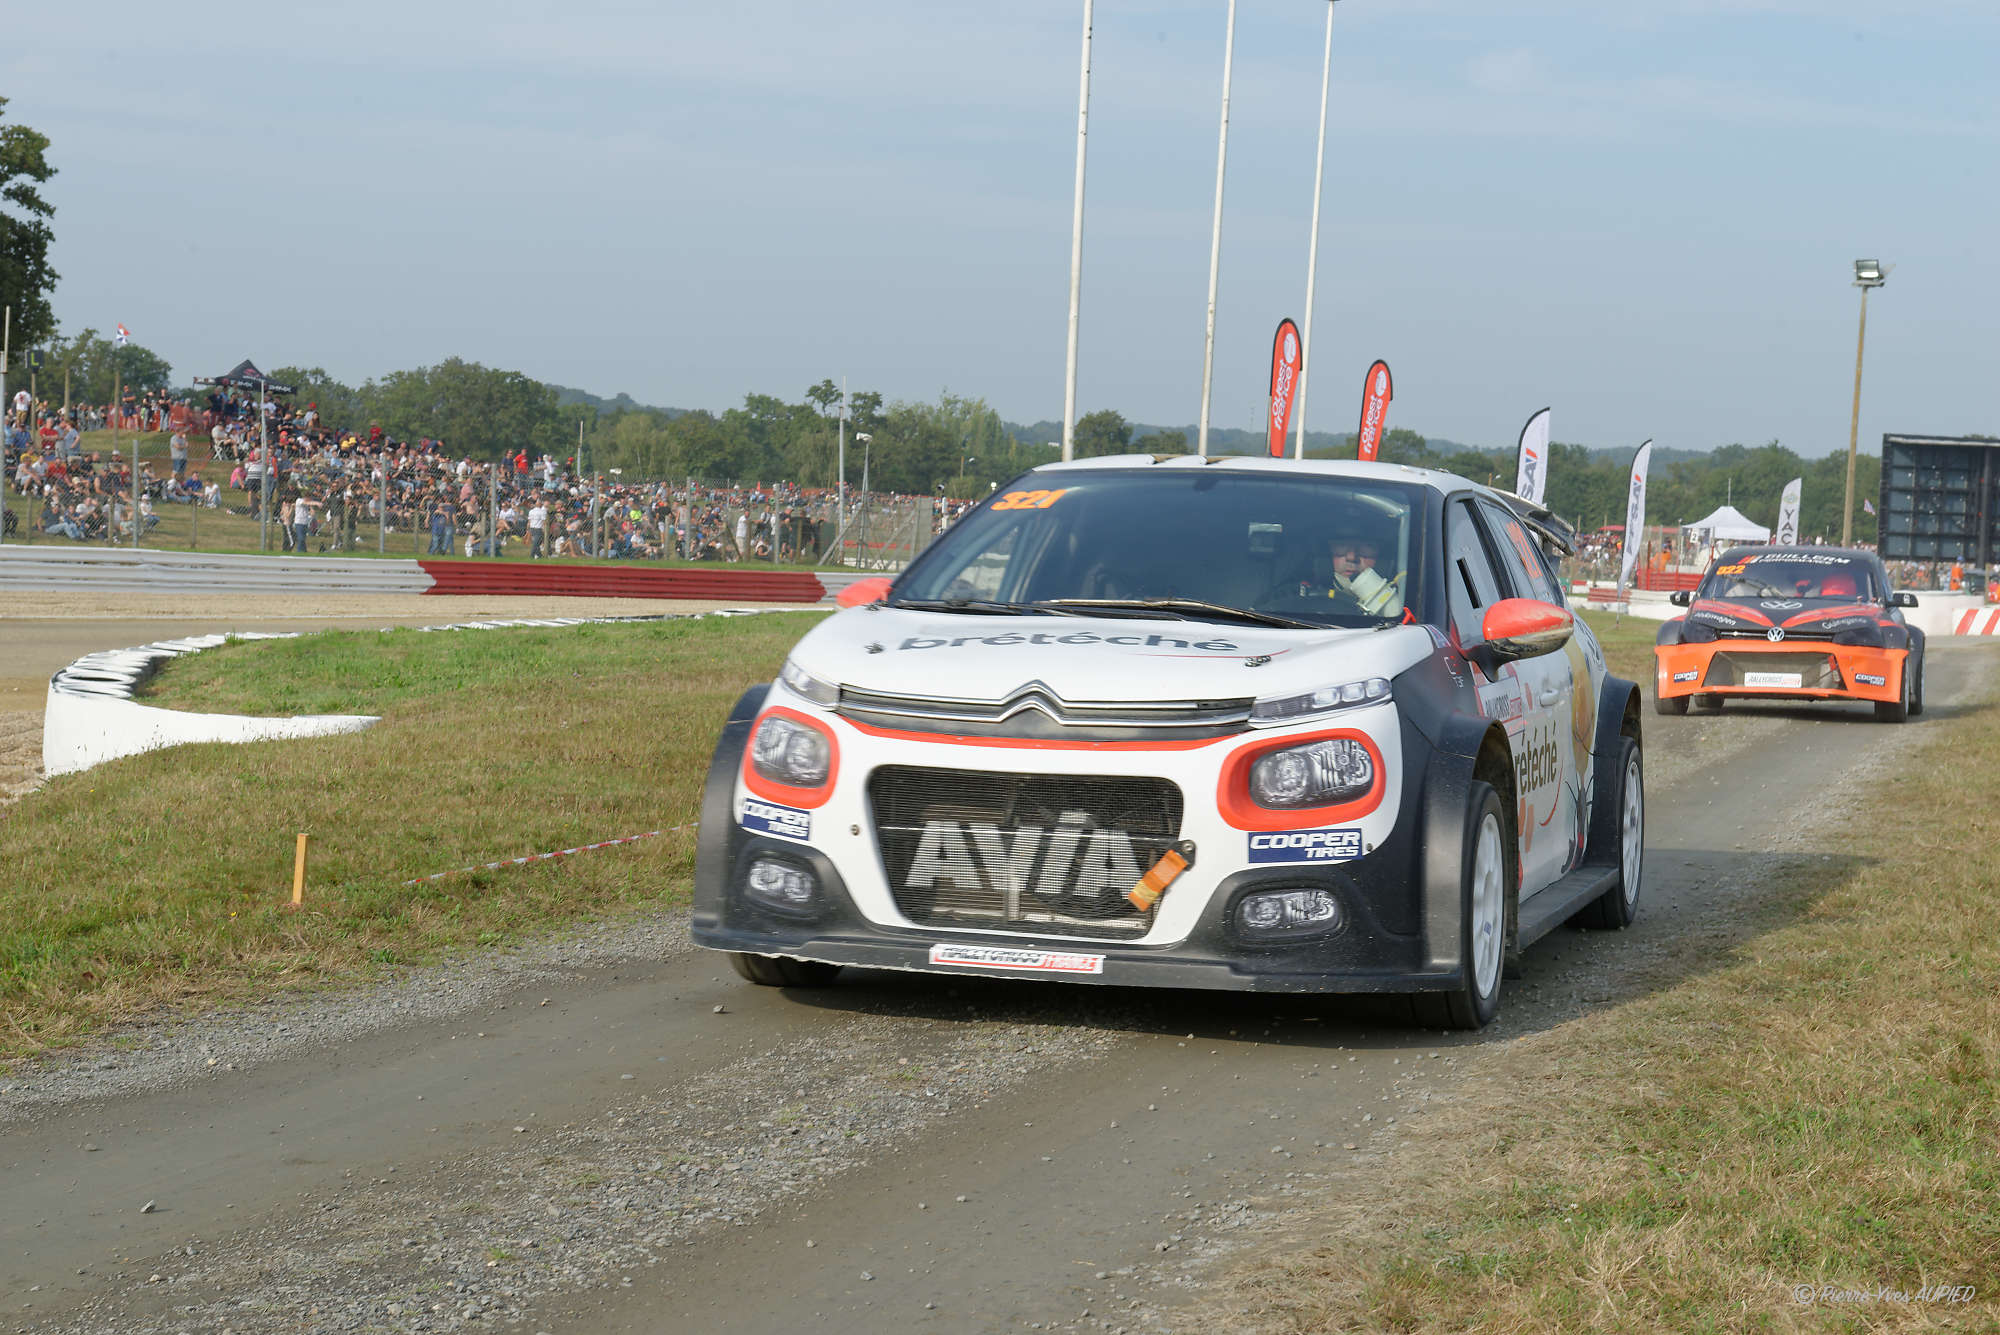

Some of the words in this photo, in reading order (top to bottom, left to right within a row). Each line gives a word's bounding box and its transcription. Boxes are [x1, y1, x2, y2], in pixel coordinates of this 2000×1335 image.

[31, 352, 39, 366] L
[990, 489, 1067, 511] 321
[1781, 508, 1795, 545] YAC
[899, 632, 1239, 651] brétéché
[1514, 716, 1558, 796] rétéché
[743, 801, 810, 827] COOPER
[767, 820, 809, 837] TIRES
[1250, 831, 1360, 850] COOPER
[1304, 846, 1360, 858] TIRES
